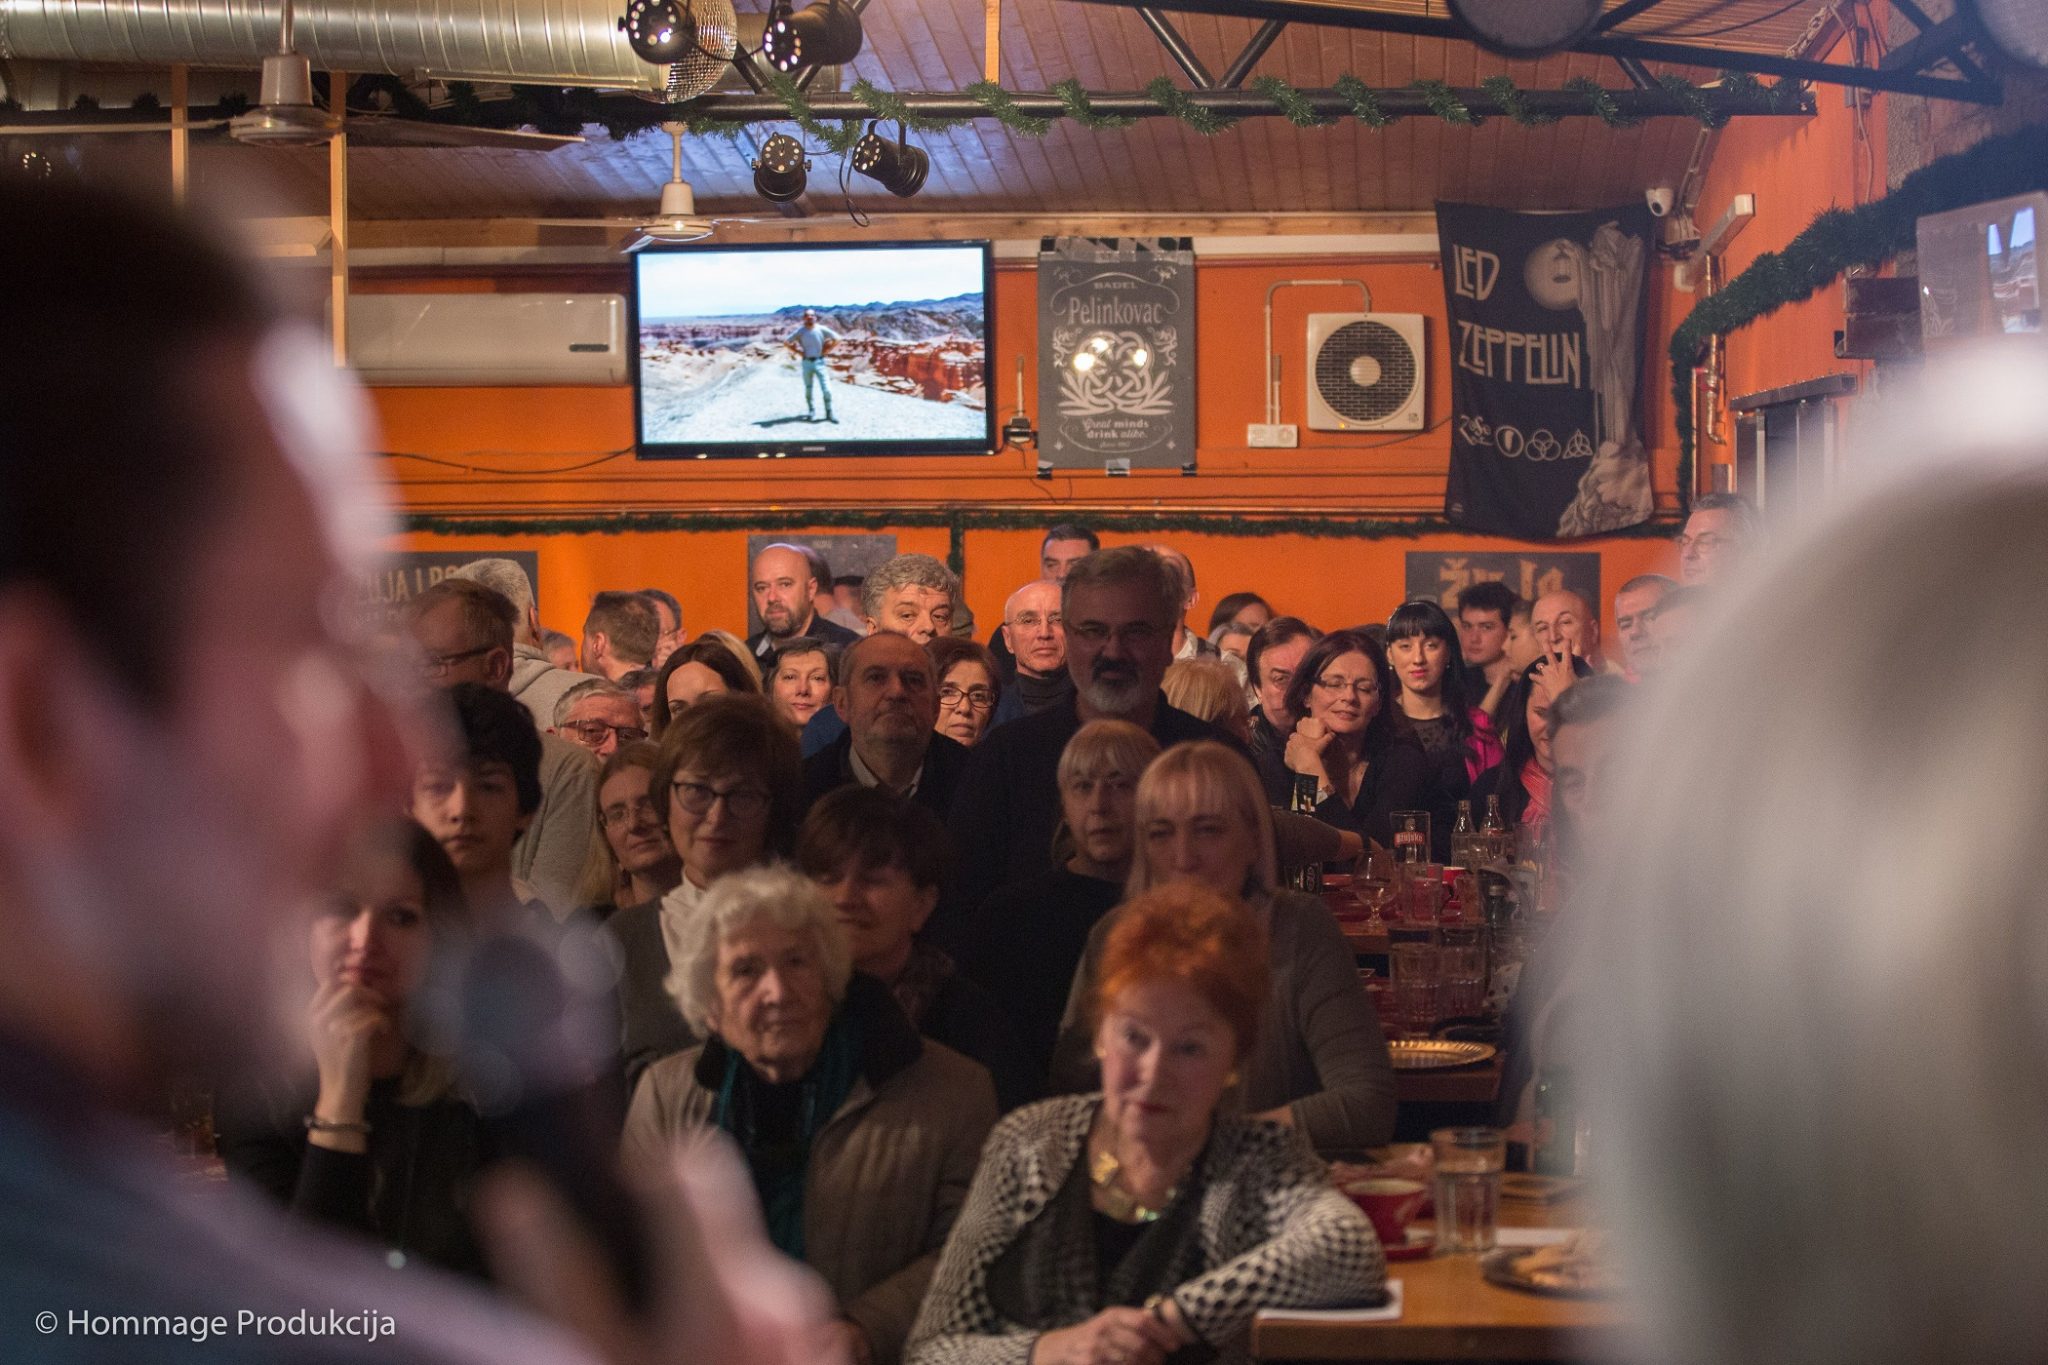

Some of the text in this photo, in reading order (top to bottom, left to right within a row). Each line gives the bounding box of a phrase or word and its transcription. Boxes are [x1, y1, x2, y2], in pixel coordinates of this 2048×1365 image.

[1453, 243, 1500, 300] LED
[1067, 294, 1163, 325] Pelinkovac
[1457, 319, 1581, 390] ZEPPELIN
[1086, 429, 1119, 439] drink
[1113, 418, 1149, 429] minds
